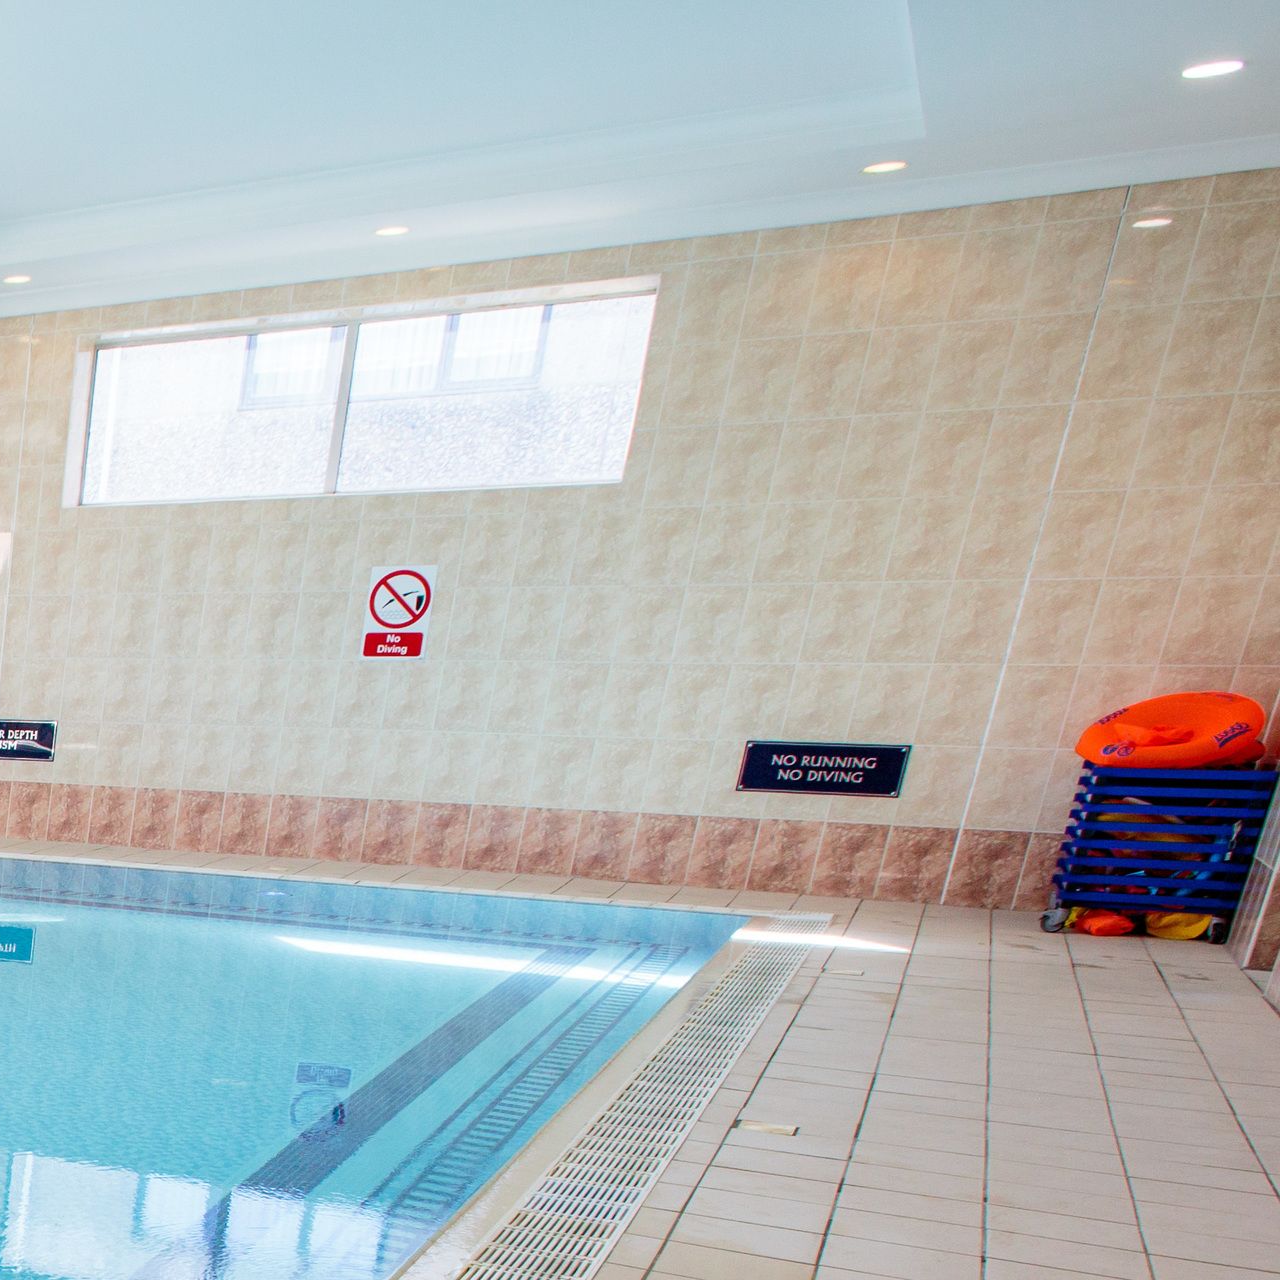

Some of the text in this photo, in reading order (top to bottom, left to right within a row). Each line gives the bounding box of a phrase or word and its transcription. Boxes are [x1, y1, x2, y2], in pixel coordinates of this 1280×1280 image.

[386, 634, 401, 643] No
[376, 644, 408, 656] Diving
[8, 730, 38, 740] DEPTH
[771, 754, 877, 769] NO RUNNING
[777, 769, 864, 784] NO DIVING
